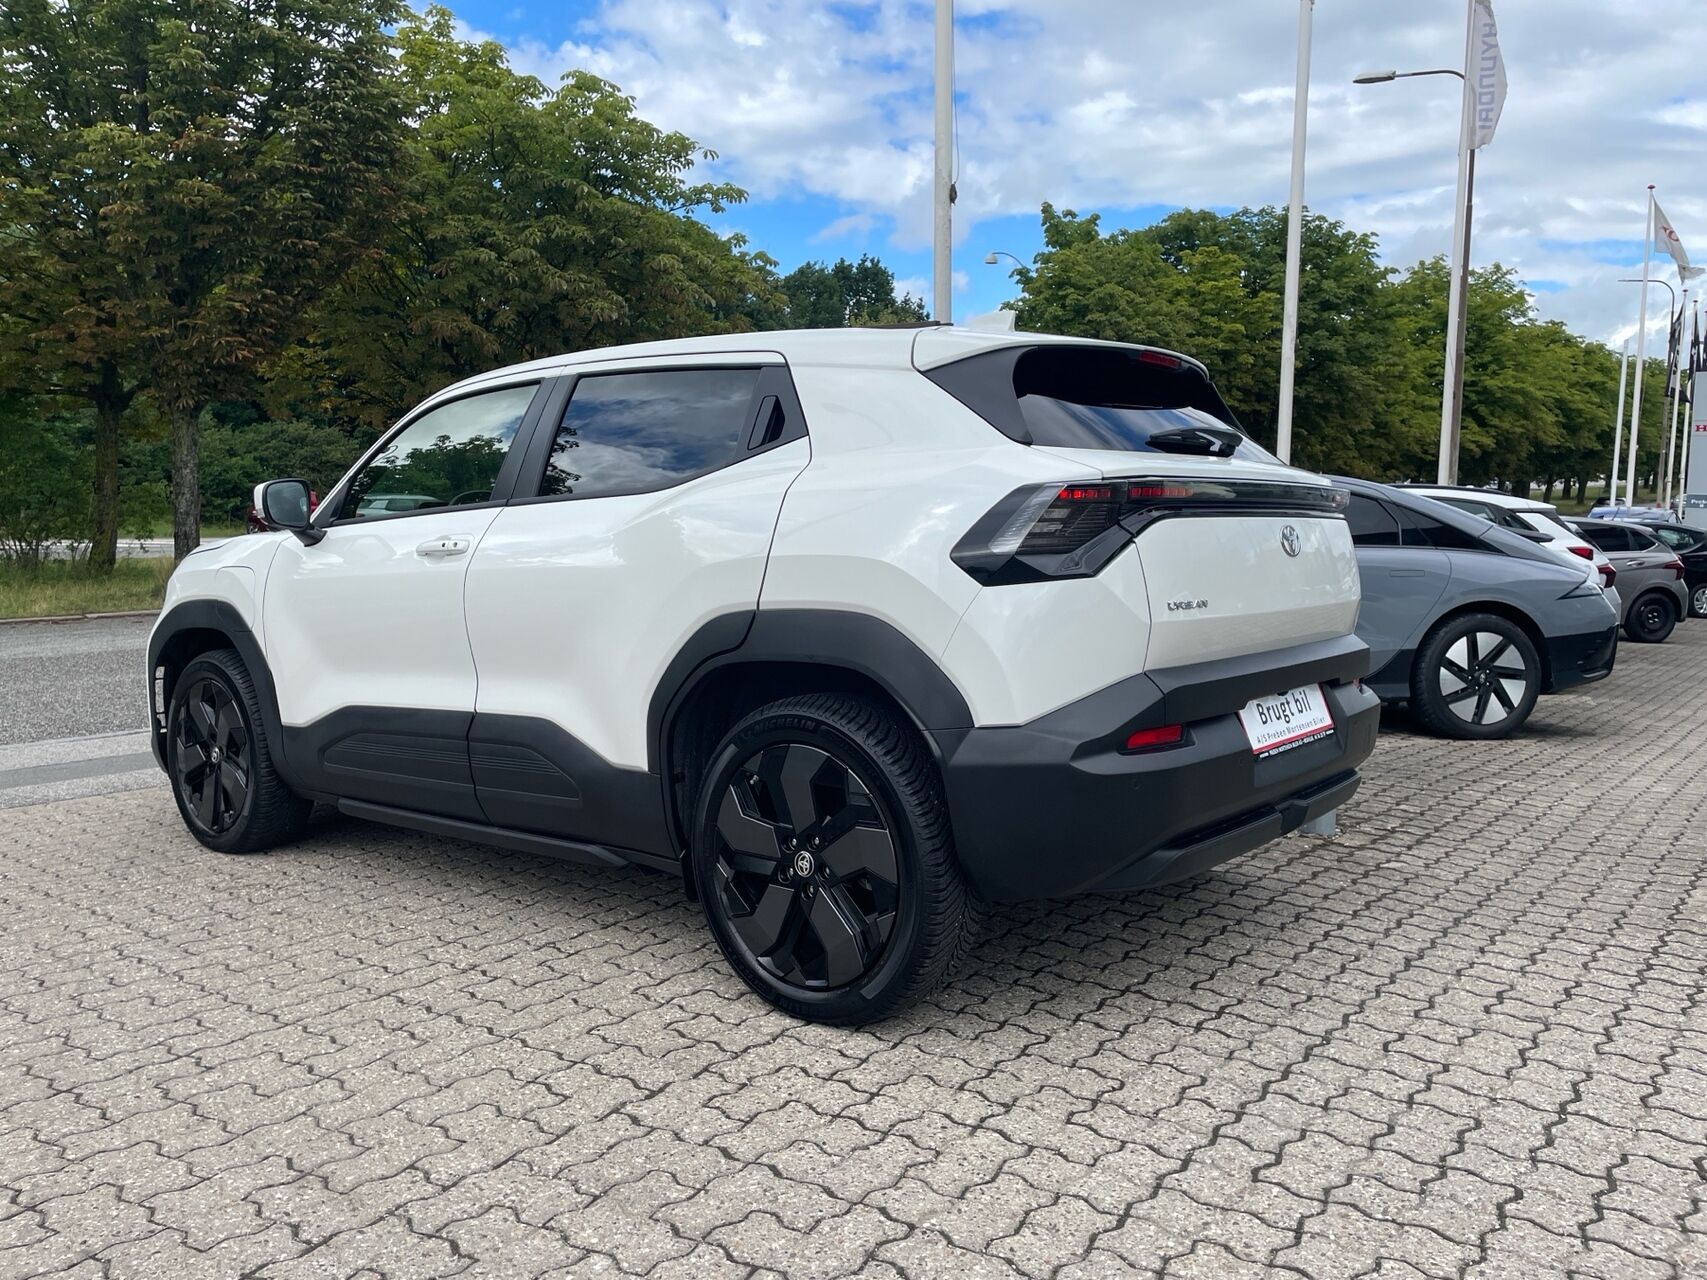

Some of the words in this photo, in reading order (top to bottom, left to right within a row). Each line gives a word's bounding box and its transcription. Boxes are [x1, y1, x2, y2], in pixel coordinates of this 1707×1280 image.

[1256, 697, 1294, 725] Brugt
[1292, 689, 1312, 713] bil
[753, 717, 817, 736] MICHELIN
